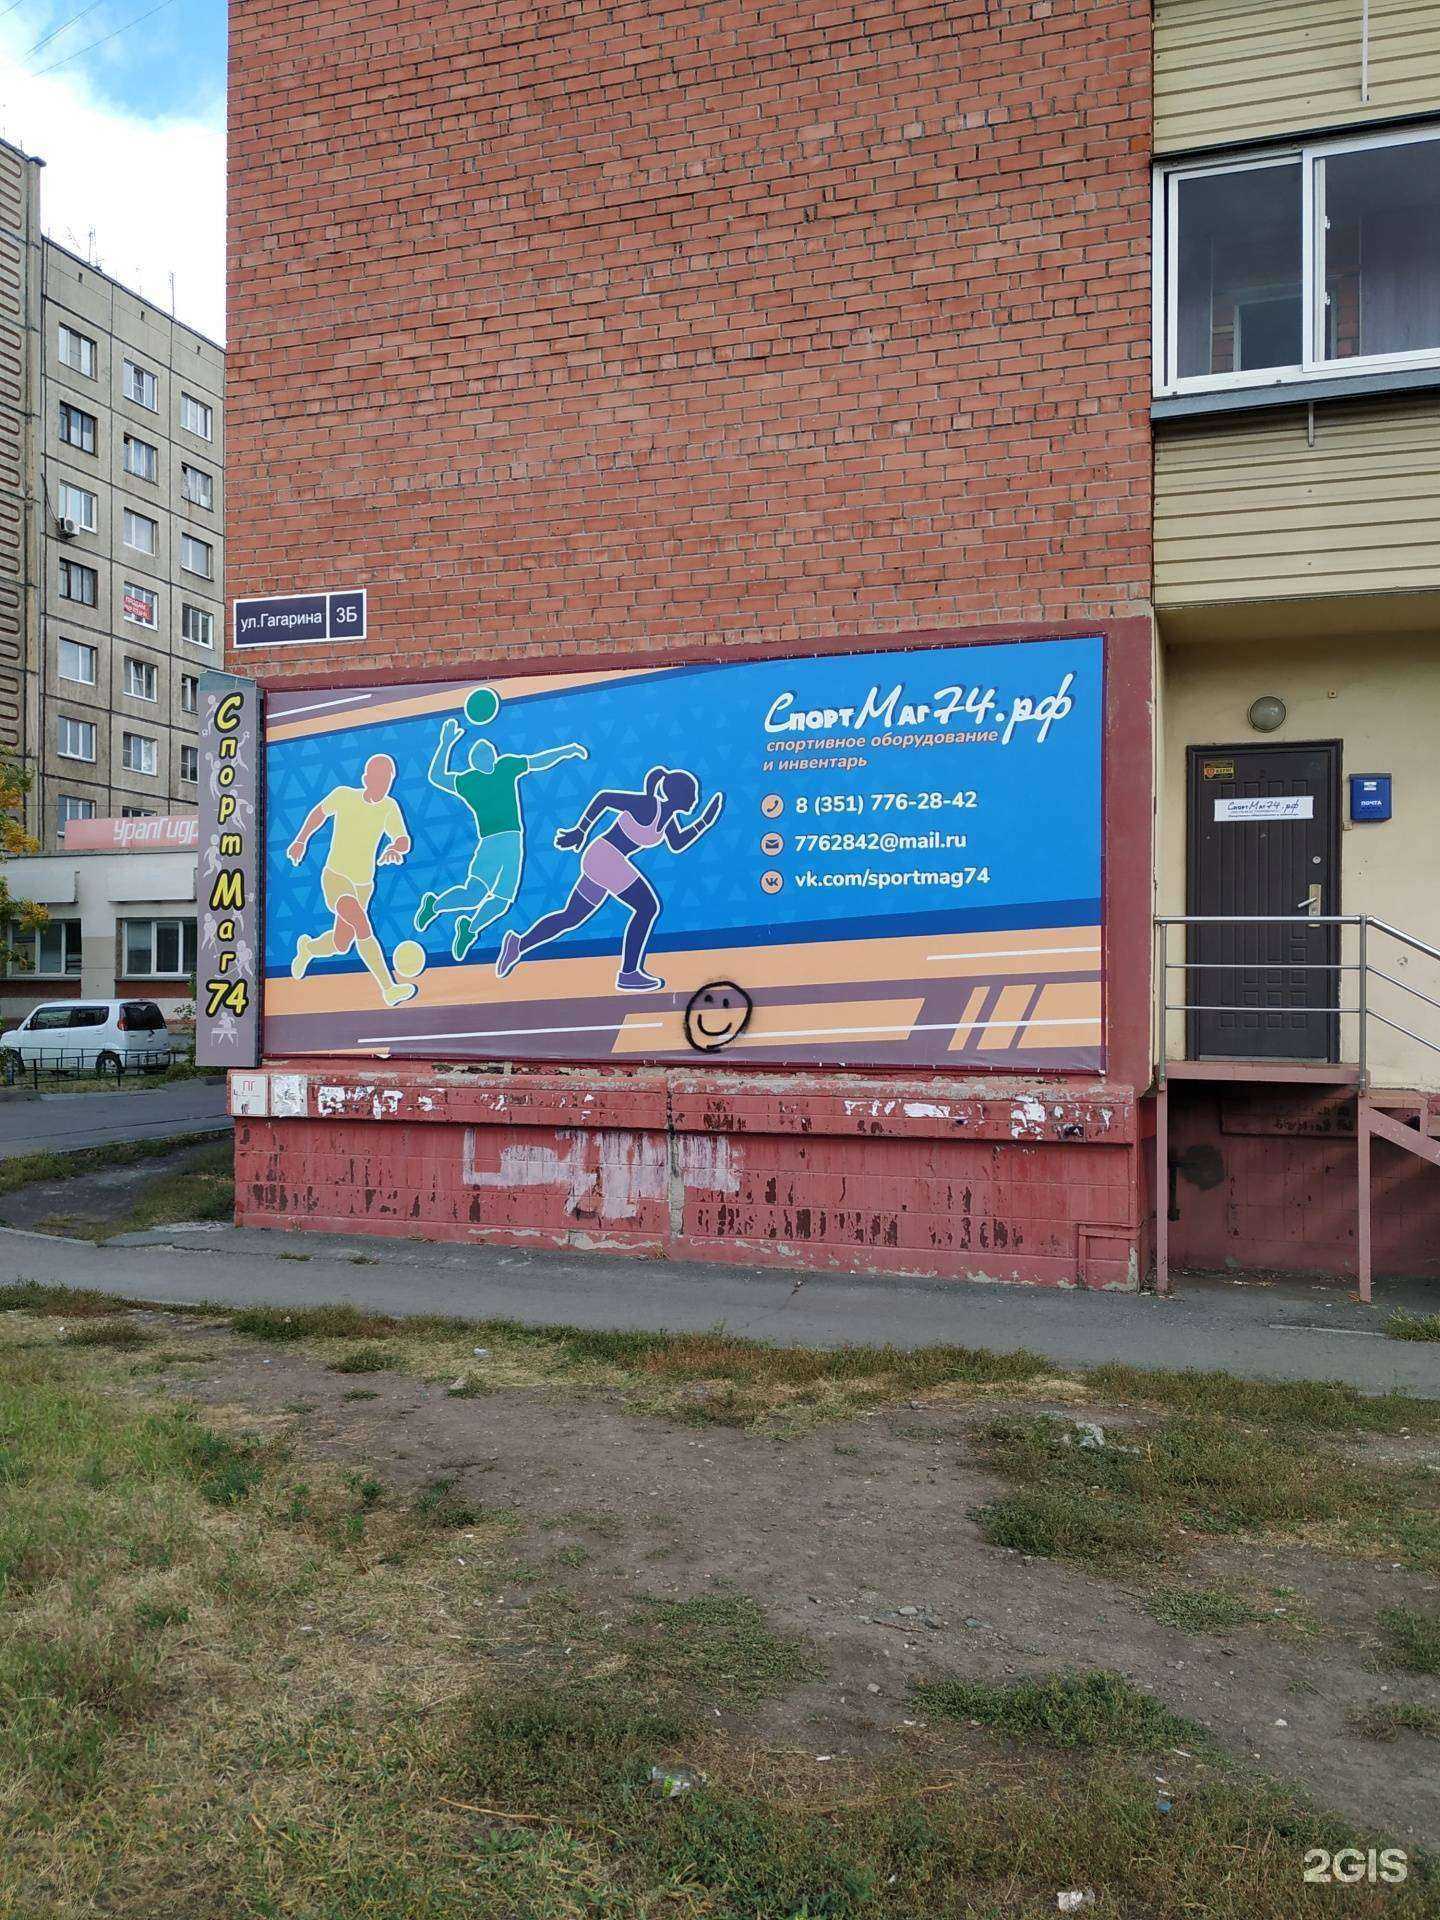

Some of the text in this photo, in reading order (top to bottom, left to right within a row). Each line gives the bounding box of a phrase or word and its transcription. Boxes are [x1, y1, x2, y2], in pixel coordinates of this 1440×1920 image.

[240, 606, 358, 633] ул.Гагарина 3Б
[766, 728, 999, 753] спортивное оборудование
[762, 755, 868, 772] и инвентарь
[795, 791, 978, 816] 8 (351) 776-28-42
[794, 831, 967, 853] 7762842@mail.ru
[794, 867, 991, 889] vk.com/sportmag74
